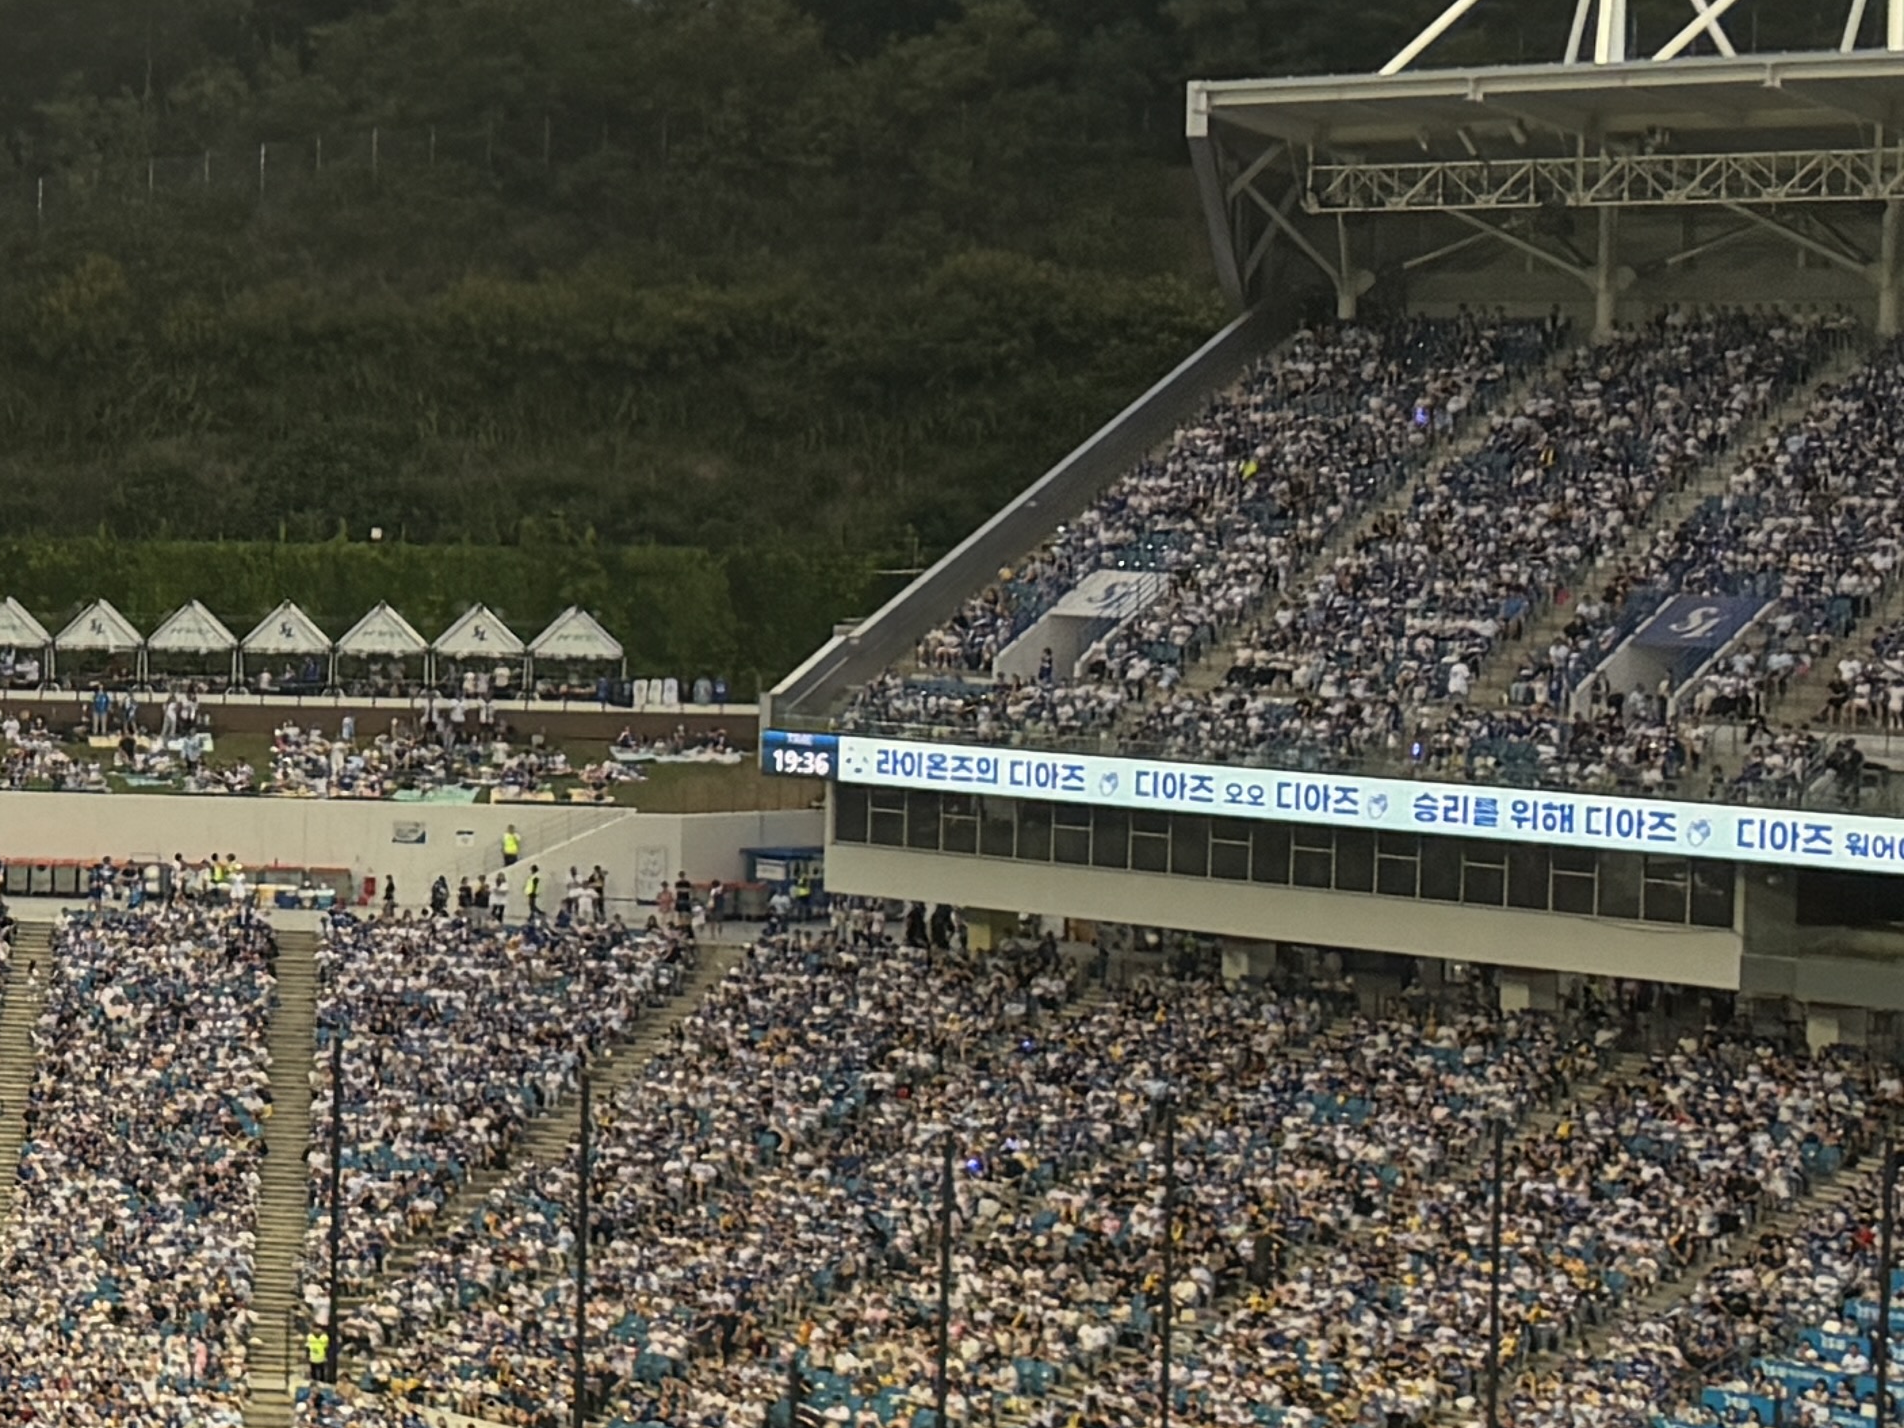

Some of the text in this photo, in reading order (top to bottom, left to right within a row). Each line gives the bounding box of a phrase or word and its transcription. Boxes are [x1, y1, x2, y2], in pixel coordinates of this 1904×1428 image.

[772, 748, 829, 774] 19:36
[876, 749, 999, 785] 라이온즈의
[1009, 760, 1085, 792] 디아즈
[1136, 770, 1214, 804] 디아즈
[1224, 782, 1266, 806] 오오
[1276, 781, 1360, 818] 디아즈
[1412, 790, 1500, 828] 승리를
[1510, 798, 1574, 833] 위해
[1586, 806, 1677, 843] 디아즈
[1737, 818, 1833, 855] 디아즈
